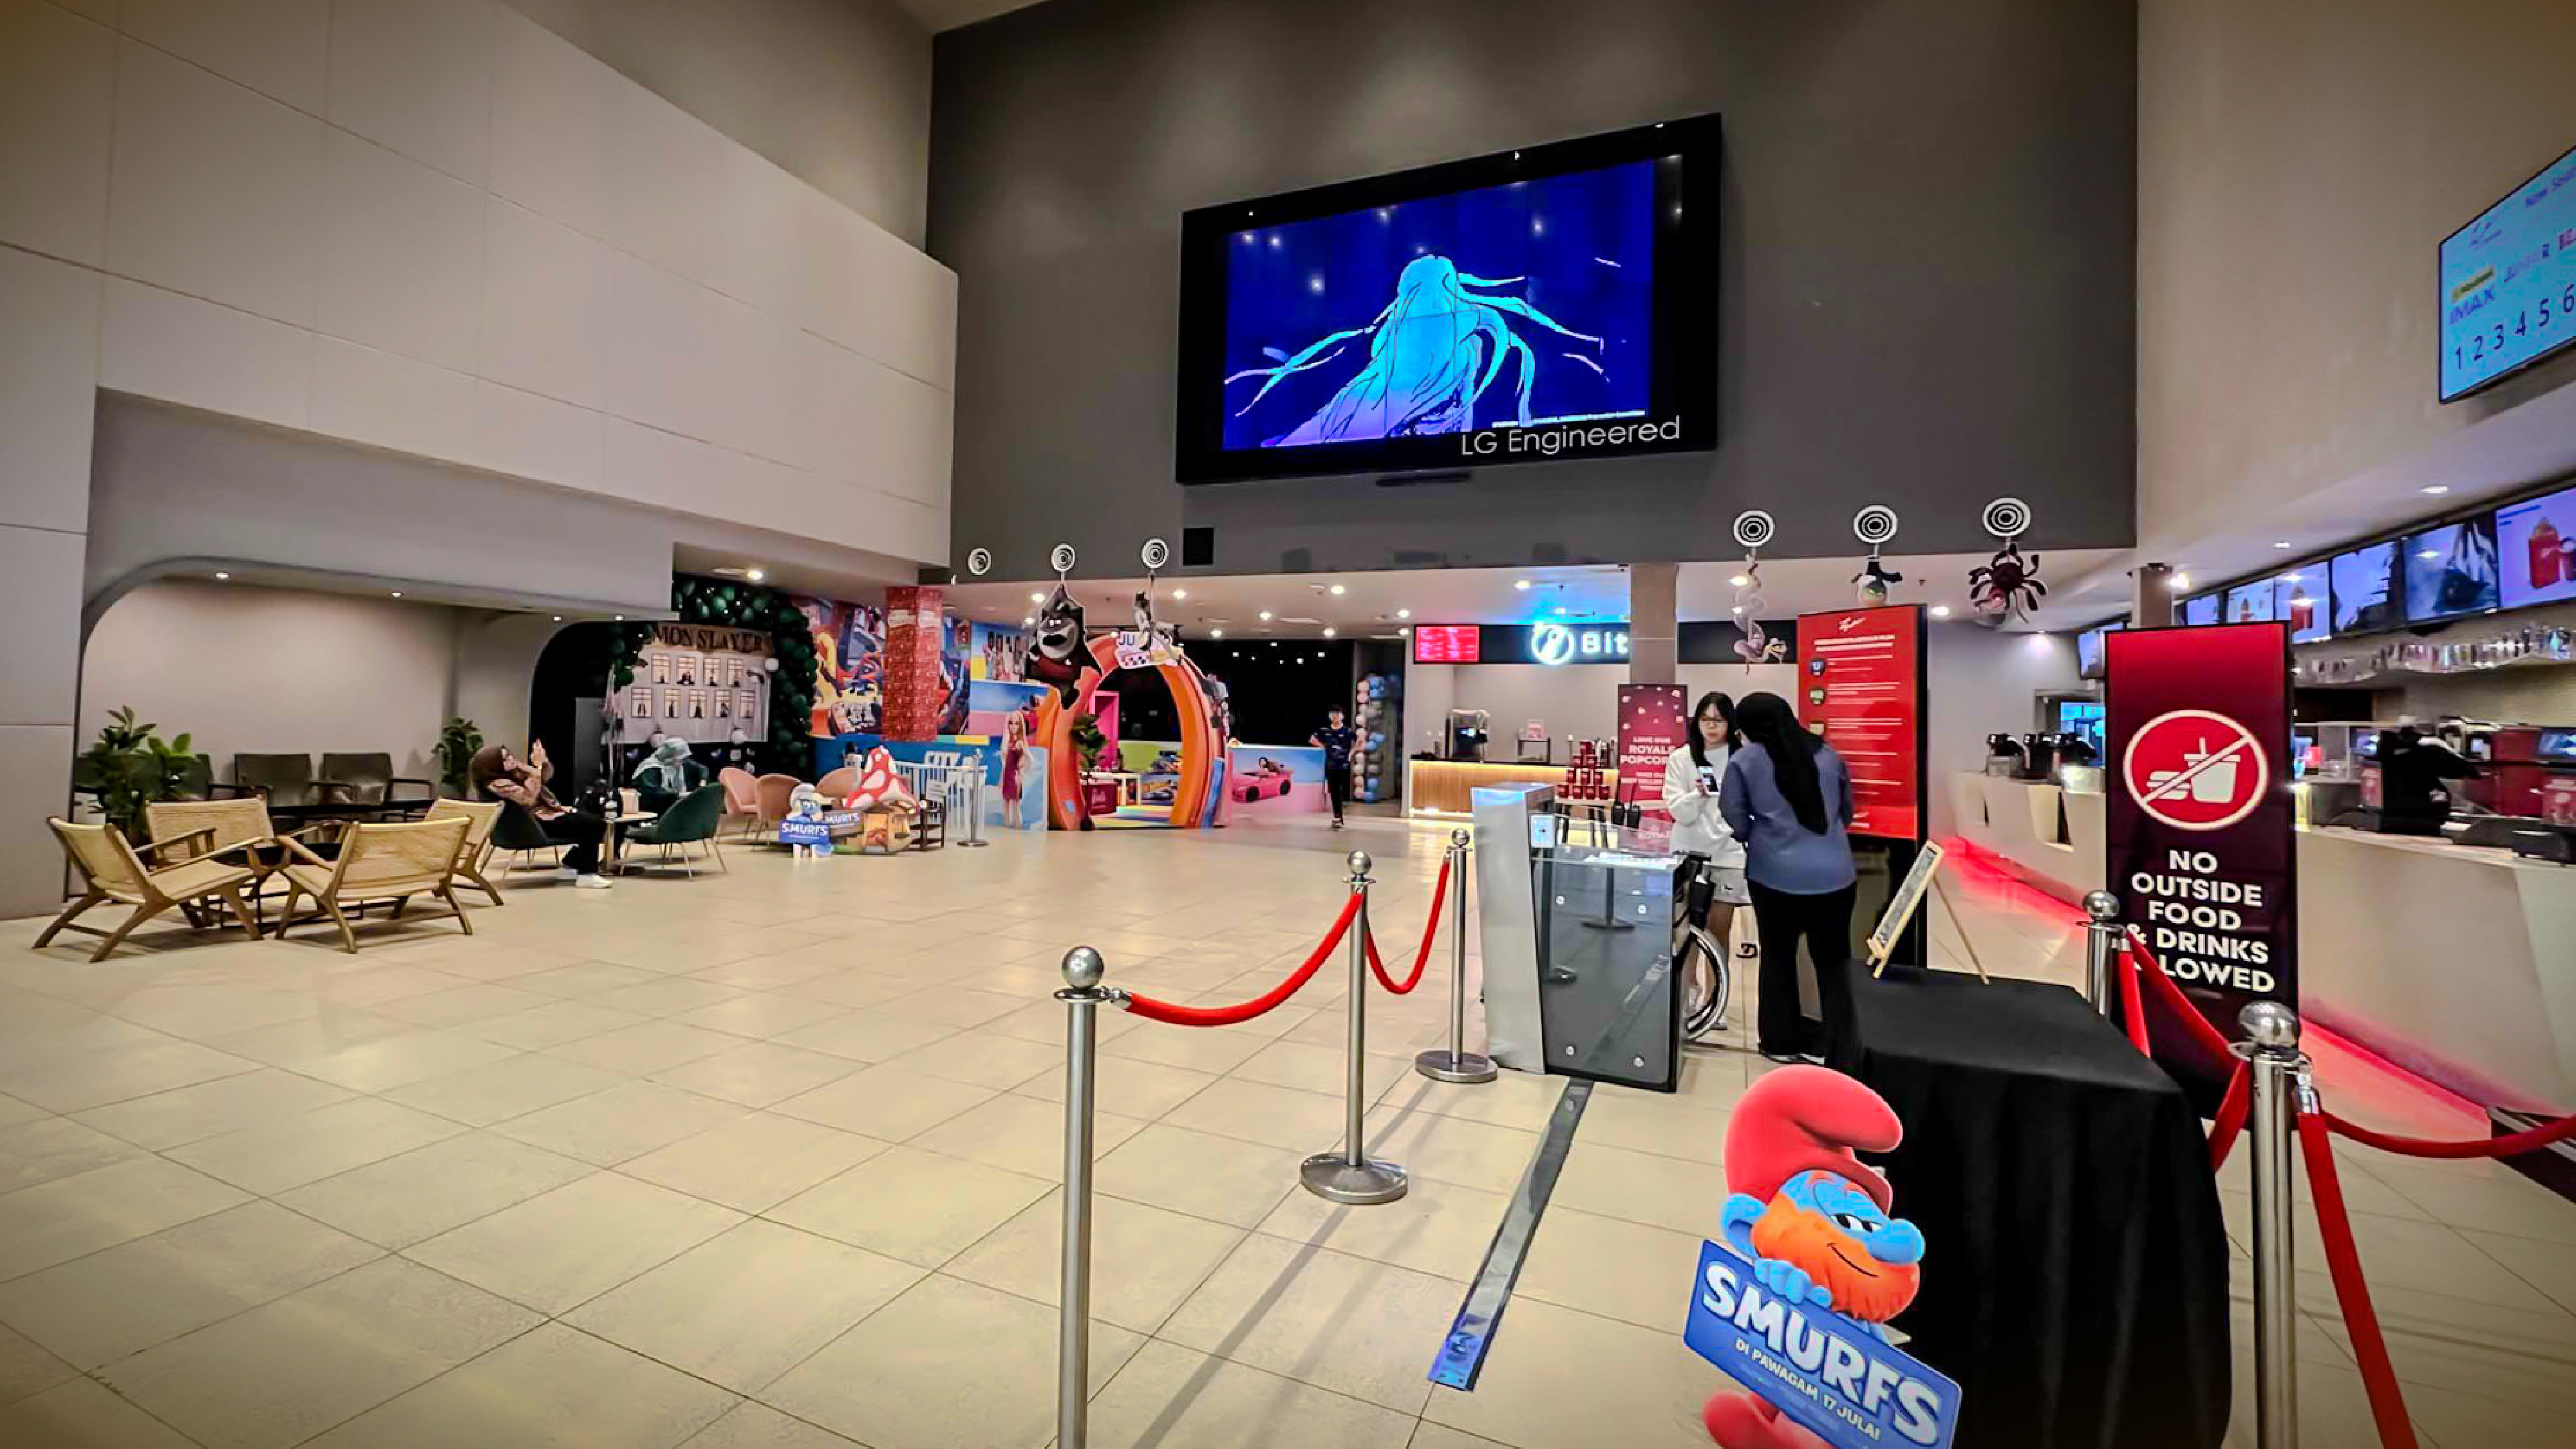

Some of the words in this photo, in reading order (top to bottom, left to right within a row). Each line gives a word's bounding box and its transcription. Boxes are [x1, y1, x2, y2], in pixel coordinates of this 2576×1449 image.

[2455, 346, 2462, 369] 1
[2474, 335, 2484, 361] 2
[2494, 324, 2504, 350] 3
[2515, 310, 2527, 337] 4
[2539, 297, 2550, 327] 5
[2563, 283, 2575, 313] 6
[1461, 431, 1498, 455] LG
[1509, 415, 1680, 454] Engineered
[1620, 754, 1668, 765] POPCOR
[782, 822, 829, 836] SMURFS
[825, 812, 860, 823] MURFS
[2169, 849, 2218, 874] NO
[2131, 872, 2263, 908] OUTSIDE
[2148, 899, 2242, 930] FOOD
[2156, 928, 2269, 964] DRINKS
[2134, 954, 2276, 993] LOWED
[1703, 1262, 1940, 1445] SMURFS
[1735, 1337, 1749, 1355] DI
[1751, 1349, 1818, 1401] PAWAGAM
[1823, 1394, 1837, 1411] 17
[1836, 1407, 1881, 1441] JULAI
